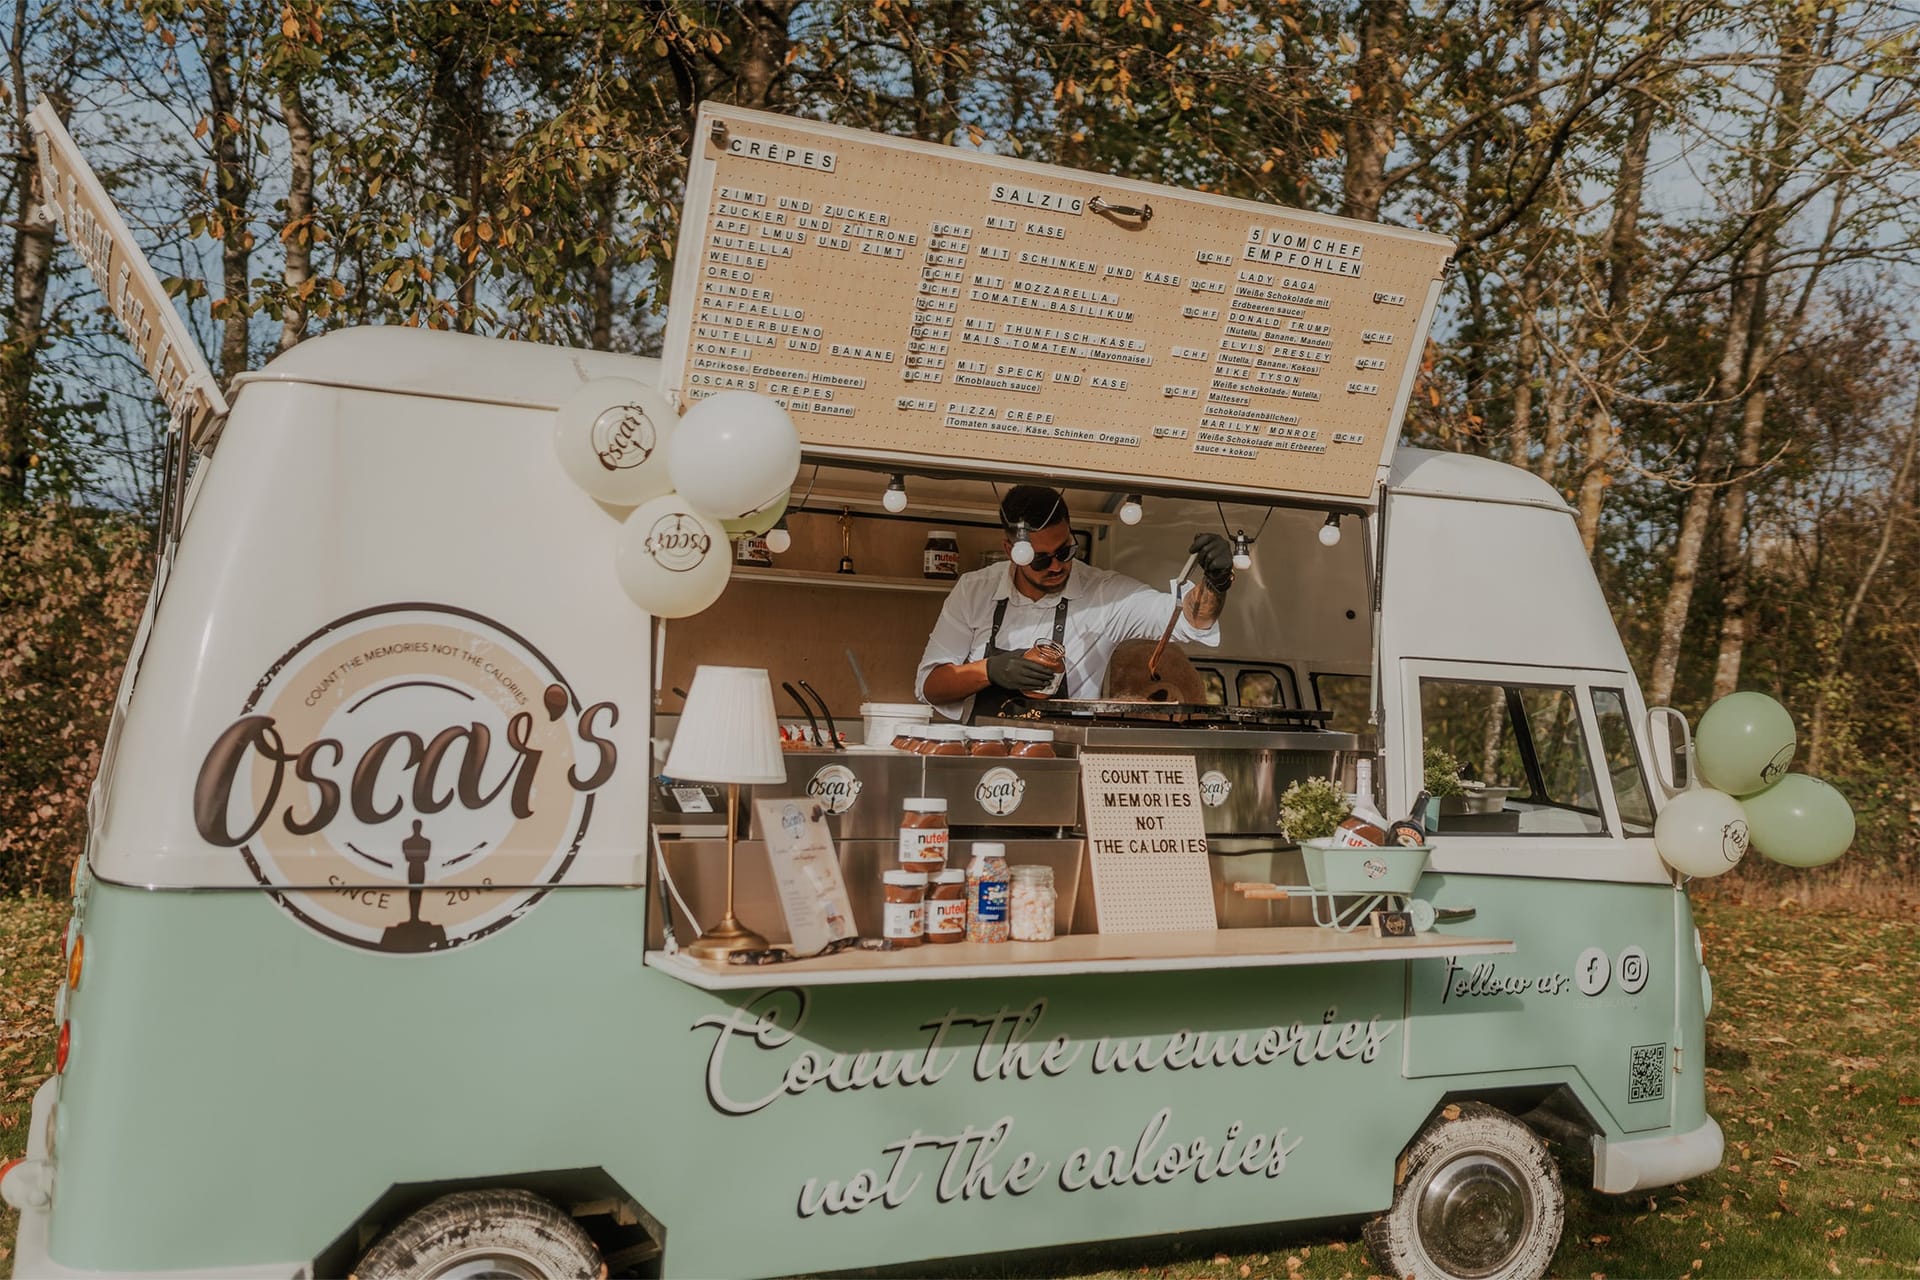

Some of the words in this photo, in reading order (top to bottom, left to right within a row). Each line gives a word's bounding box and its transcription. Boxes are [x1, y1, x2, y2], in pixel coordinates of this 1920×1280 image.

[731, 140, 831, 167] CRÊPES
[721, 189, 763, 203] ZIMT
[780, 198, 809, 211] UND
[825, 205, 887, 223] ZUCKER
[995, 187, 1080, 211] SALZIG
[718, 205, 784, 222] ZUCKER
[799, 217, 828, 230] UND
[844, 224, 915, 243] ZITRONE
[987, 217, 1015, 228] MIT
[716, 220, 746, 232] APF
[763, 227, 804, 241] LMUS
[820, 236, 848, 248] UND
[863, 244, 902, 256] ZIMT
[1252, 230, 1260, 240] 5
[713, 236, 789, 255] NUTELLA
[981, 247, 1008, 258] MIT
[1022, 253, 1095, 271] SCHINKEN
[1107, 266, 1132, 278] UND
[1247, 247, 1361, 275] EMPFOHLEN
[708, 267, 751, 280] OREO
[975, 275, 1002, 287] MIT
[1240, 272, 1273, 283] LADY
[1283, 279, 1315, 290] GAGA
[705, 283, 771, 299] KINDER
[1267, 291, 1314, 305] Schokolade
[1316, 299, 1329, 307] mit
[703, 298, 802, 319] RAFFAELLO
[1232, 300, 1275, 313] Erdbeeren
[701, 313, 821, 337] KINDERBUENO
[966, 319, 993, 330] MIT
[1229, 313, 1280, 326] DONALD
[1291, 321, 1329, 333] TRUMP
[696, 344, 748, 357] KONFI
[698, 328, 773, 345] NUTELLA
[789, 340, 818, 351] UND
[832, 345, 892, 359] BANANE
[1222, 341, 1263, 352] ELVIS
[1274, 347, 1330, 361] PRESLEY
[812, 373, 863, 387] Himbeere)
[957, 361, 985, 372] MIT
[998, 366, 1043, 379] SPECK
[1055, 373, 1080, 384] UND
[1216, 366, 1248, 377] MIKE
[1260, 372, 1300, 383] TYSON
[691, 375, 756, 390] OSCARS
[955, 375, 1007, 388] (Knoblauch
[1010, 382, 1041, 393] sauce)
[1209, 393, 1248, 404] Maltesers
[792, 401, 808, 410] mit
[814, 403, 853, 415] Banane)
[950, 404, 995, 416] PIZZA
[946, 417, 988, 429] (Tomaten
[1054, 428, 1094, 440] Schinken
[1201, 419, 1259, 432] MARILYN
[1269, 427, 1316, 439] MONROE
[1226, 435, 1273, 447] Schokolade
[305, 671, 340, 706] COUNT
[340, 657, 363, 674] THE
[365, 642, 428, 662] MEMORIES
[432, 644, 458, 657] NOT
[462, 651, 483, 668] THE
[484, 663, 528, 706] CALORIES
[194, 683, 619, 847] Oscar's
[1101, 770, 1149, 784] COUNT
[1155, 770, 1184, 784] THE
[808, 778, 862, 795] Oscar's
[976, 778, 1025, 800] Oscar's
[1104, 793, 1191, 807] MEMORIES
[1136, 816, 1164, 830] NOT
[918, 832, 949, 844] nutell
[1094, 839, 1124, 853] THE
[1129, 839, 1207, 853] CALORIES
[937, 902, 966, 915] nutell
[1441, 956, 1533, 1004] Follow
[690, 985, 972, 1116] Count
[973, 997, 1086, 1082] the
[1091, 1005, 1397, 1067] memories
[797, 1129, 938, 1219] not
[937, 1115, 1050, 1203] the
[1057, 1106, 1303, 1193] calories
